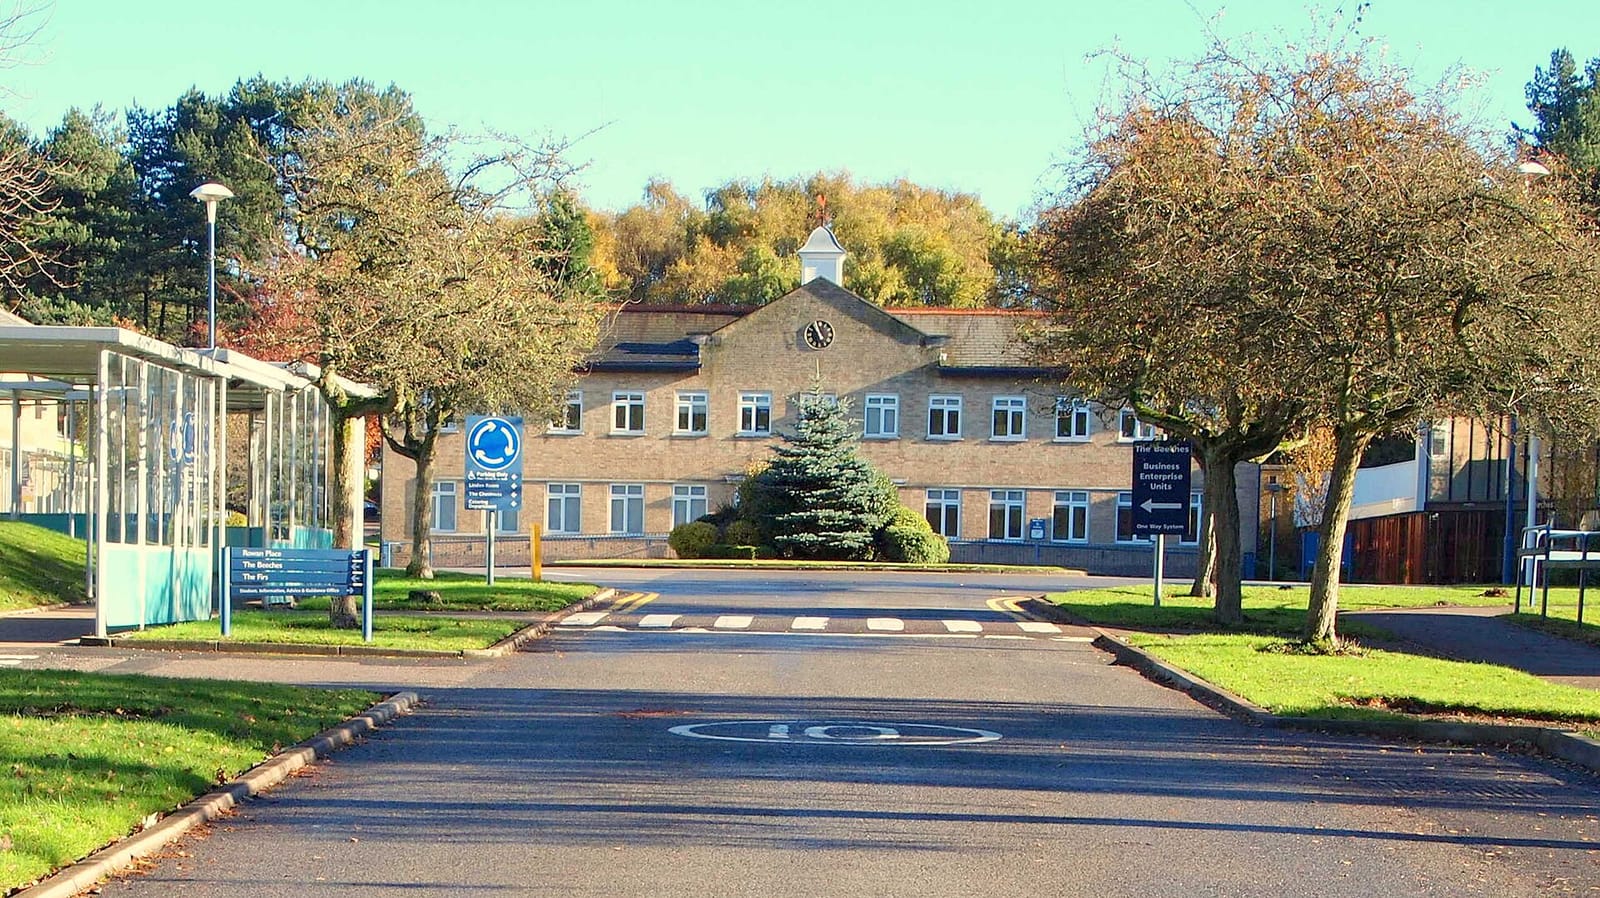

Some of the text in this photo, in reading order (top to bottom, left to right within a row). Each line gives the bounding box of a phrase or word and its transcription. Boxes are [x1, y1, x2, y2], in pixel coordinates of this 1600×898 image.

[1135, 445, 1151, 453] The
[1143, 462, 1180, 470] Business
[1140, 472, 1183, 481] Enterprise
[1150, 482, 1172, 490] Units
[1163, 523, 1184, 531] System
[242, 549, 282, 557] Rowan Place
[242, 561, 283, 569] The Beeches
[242, 573, 269, 581] The Firs
[768, 725, 901, 739] 10
